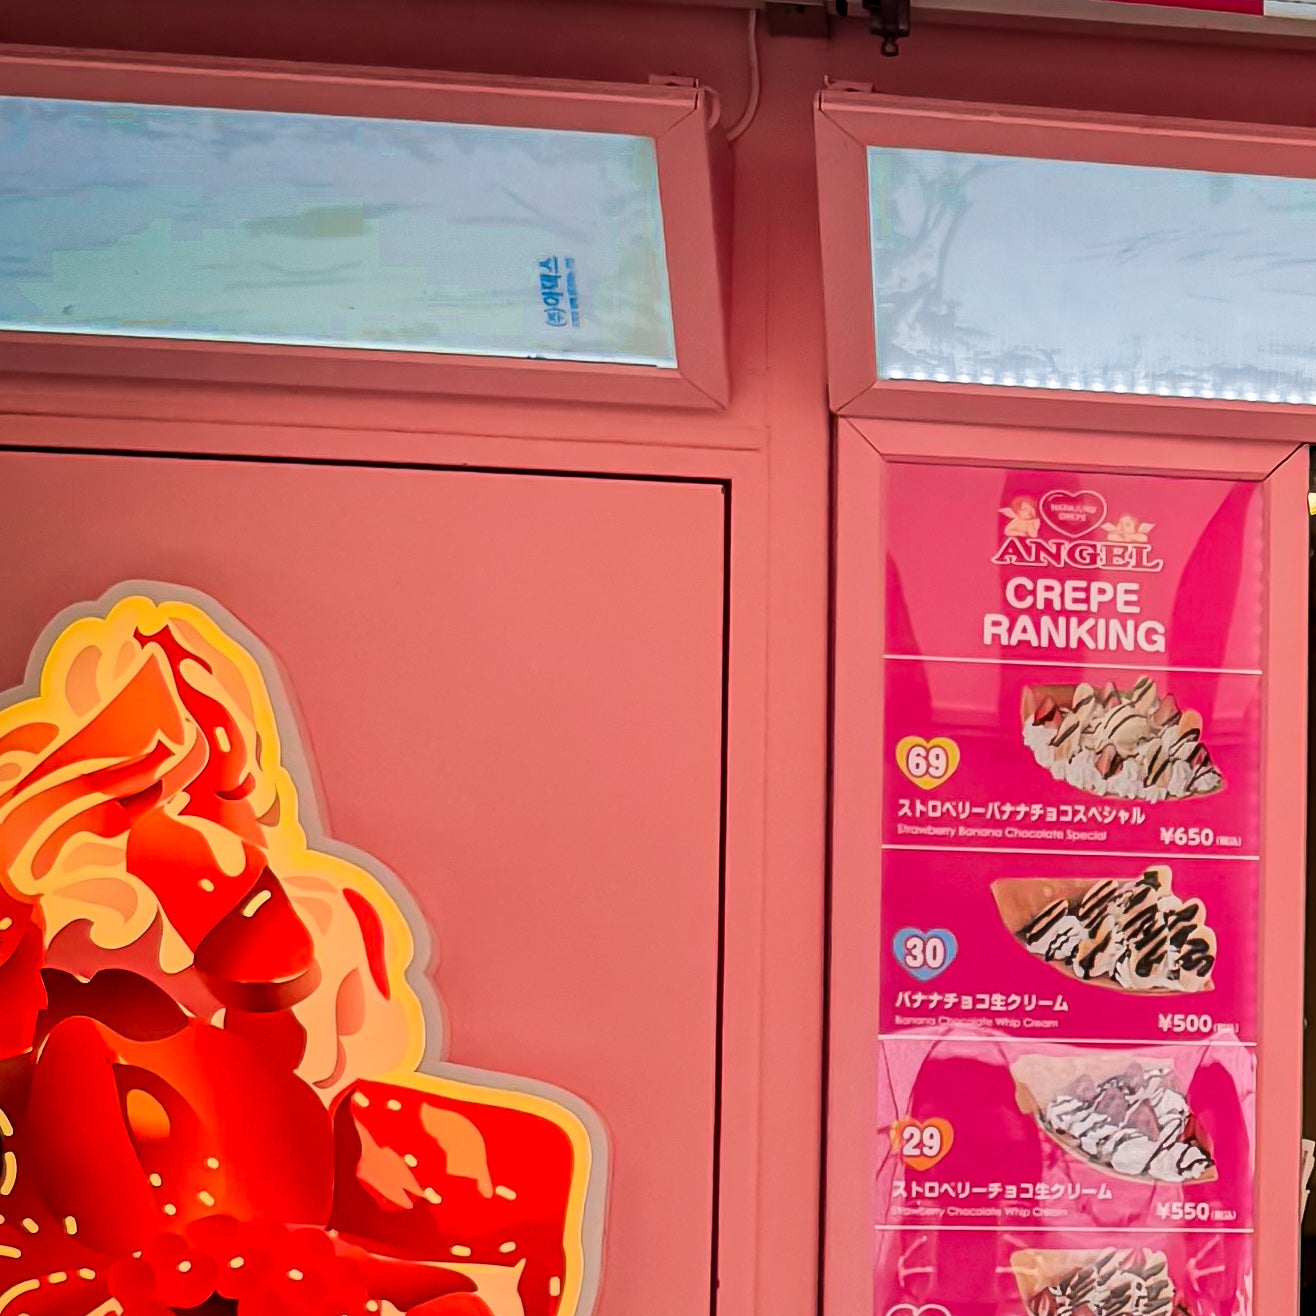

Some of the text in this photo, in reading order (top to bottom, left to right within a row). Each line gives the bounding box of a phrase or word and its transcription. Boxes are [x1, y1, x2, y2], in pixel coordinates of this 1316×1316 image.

[990, 537, 1165, 573] ANGEL
[1005, 576, 1141, 613] CREPE
[983, 614, 1166, 653] RANKING
[907, 745, 948, 777] 69
[897, 800, 1147, 825] ストロベリーバナナチョコスペシャル
[1160, 827, 1214, 847] ¥650
[904, 936, 943, 969] 30
[894, 991, 1069, 1012] バナナチョコ生クリーム
[1158, 1013, 1212, 1033] ¥500
[901, 1126, 941, 1158] 29
[892, 1180, 1113, 1201] ストロベリーチョコ生クリーム
[1156, 1202, 1210, 1221] ¥550
